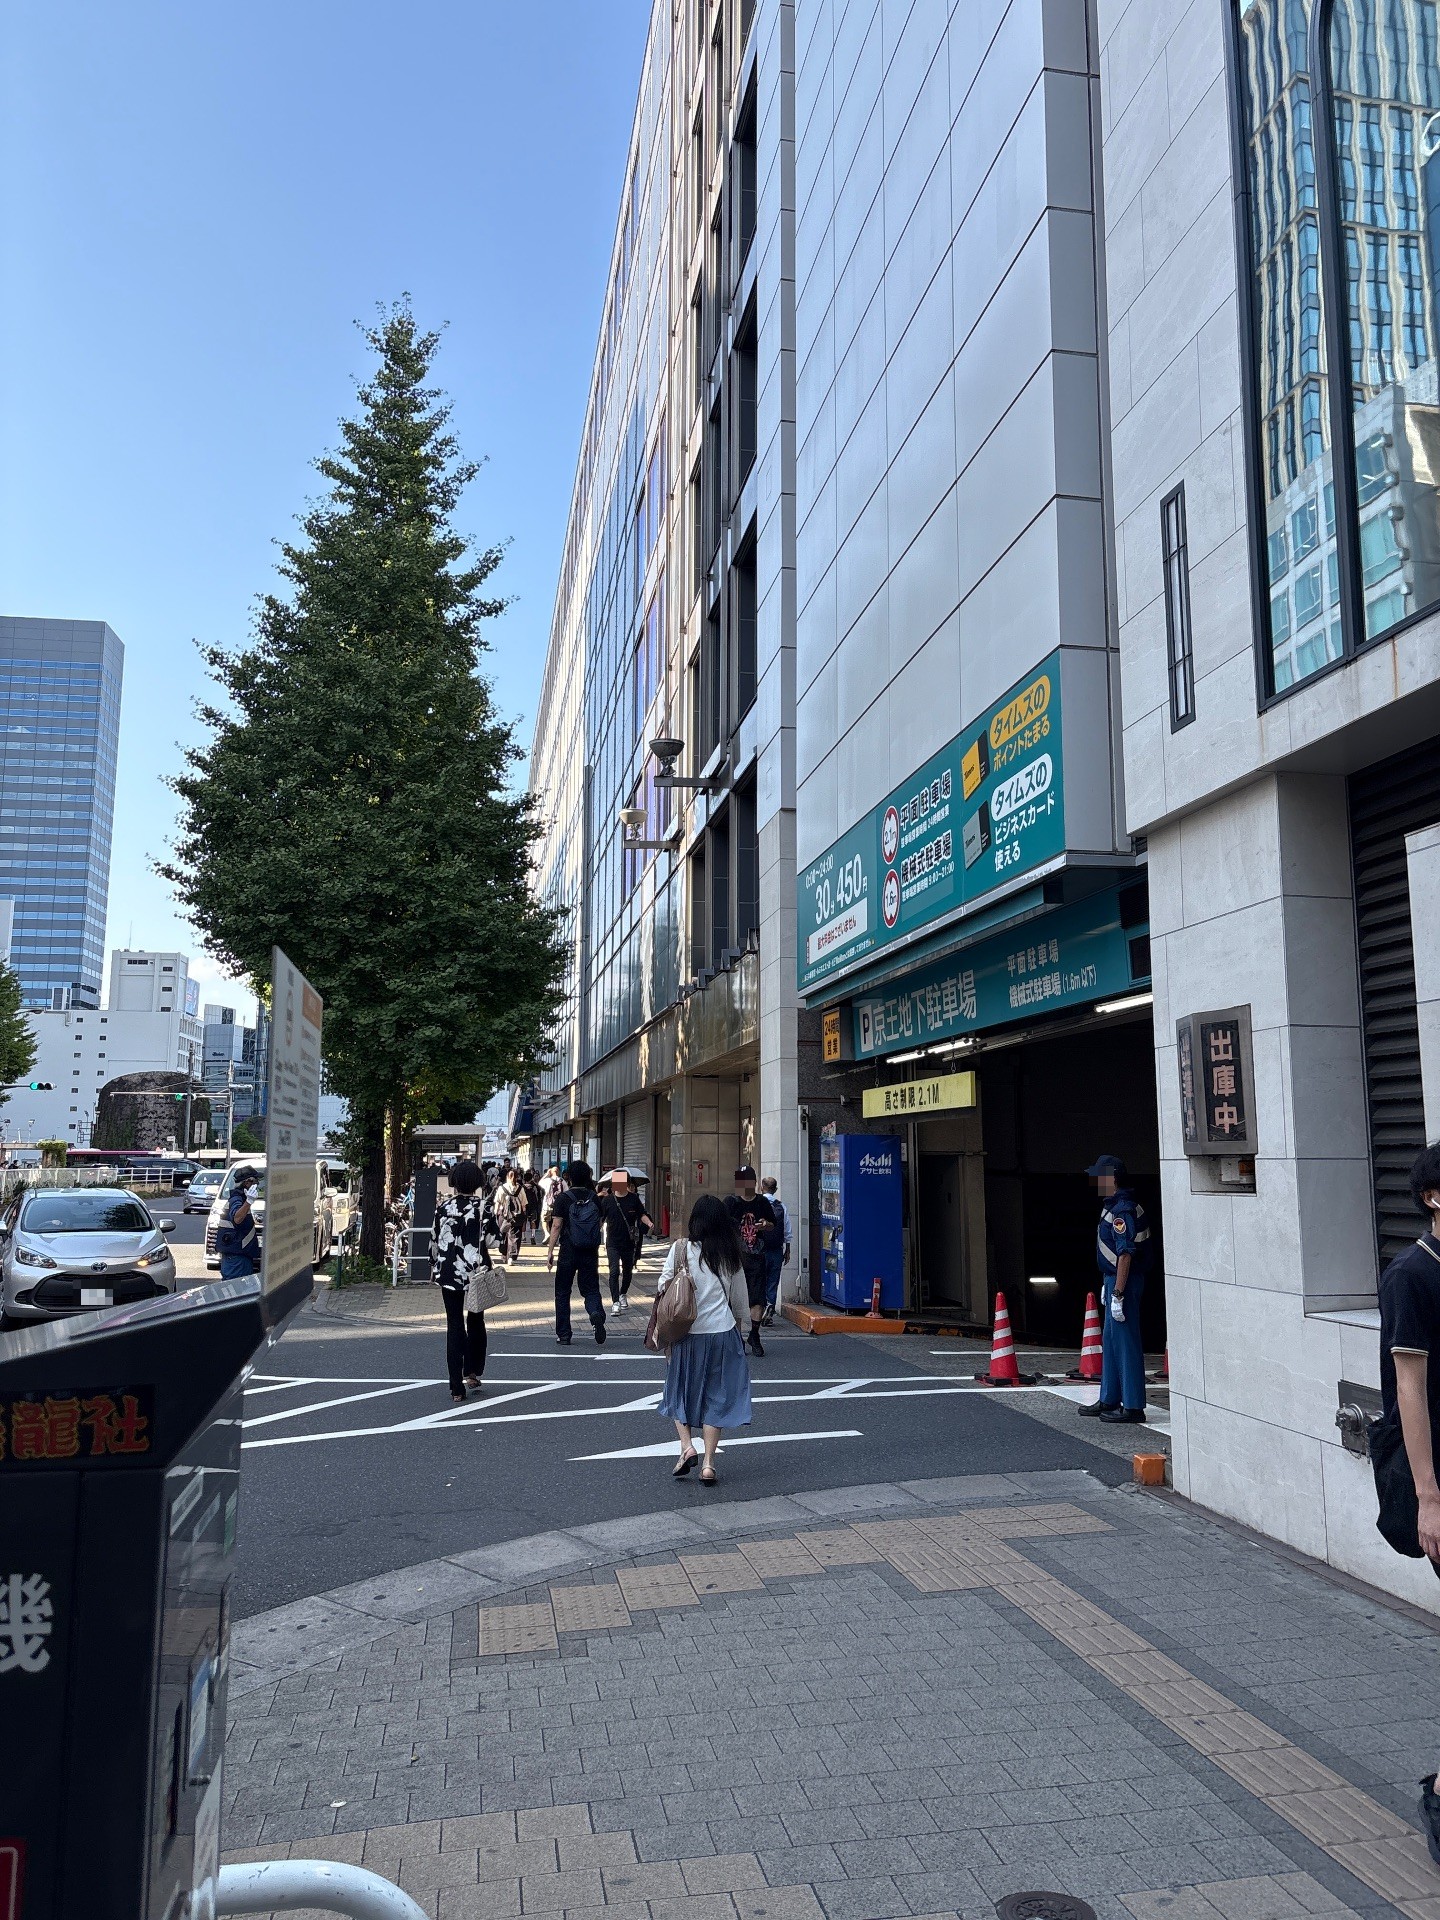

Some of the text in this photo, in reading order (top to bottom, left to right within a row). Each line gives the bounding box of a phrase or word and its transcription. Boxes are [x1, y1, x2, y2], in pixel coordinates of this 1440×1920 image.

[994, 684, 1045, 744] タイムズの
[994, 714, 1050, 772] ポイントたまる
[900, 769, 951, 831] 平面駐車場
[995, 761, 1047, 816] タイムズの
[995, 791, 1054, 844] ビジネスカード
[901, 829, 952, 887] 機械式駐車場
[995, 840, 1020, 872] 使える
[1007, 939, 1059, 977] 平面駐車場
[873, 969, 976, 1046] 京王地下駐車場
[1009, 972, 1061, 1008] 機械式駐車場
[884, 1083, 940, 1111] 高さ制限 2.1M
[1210, 1029, 1238, 1134] 出庫中
[859, 1153, 891, 1166] Asahi
[0, 1394, 150, 1460] 龍社
